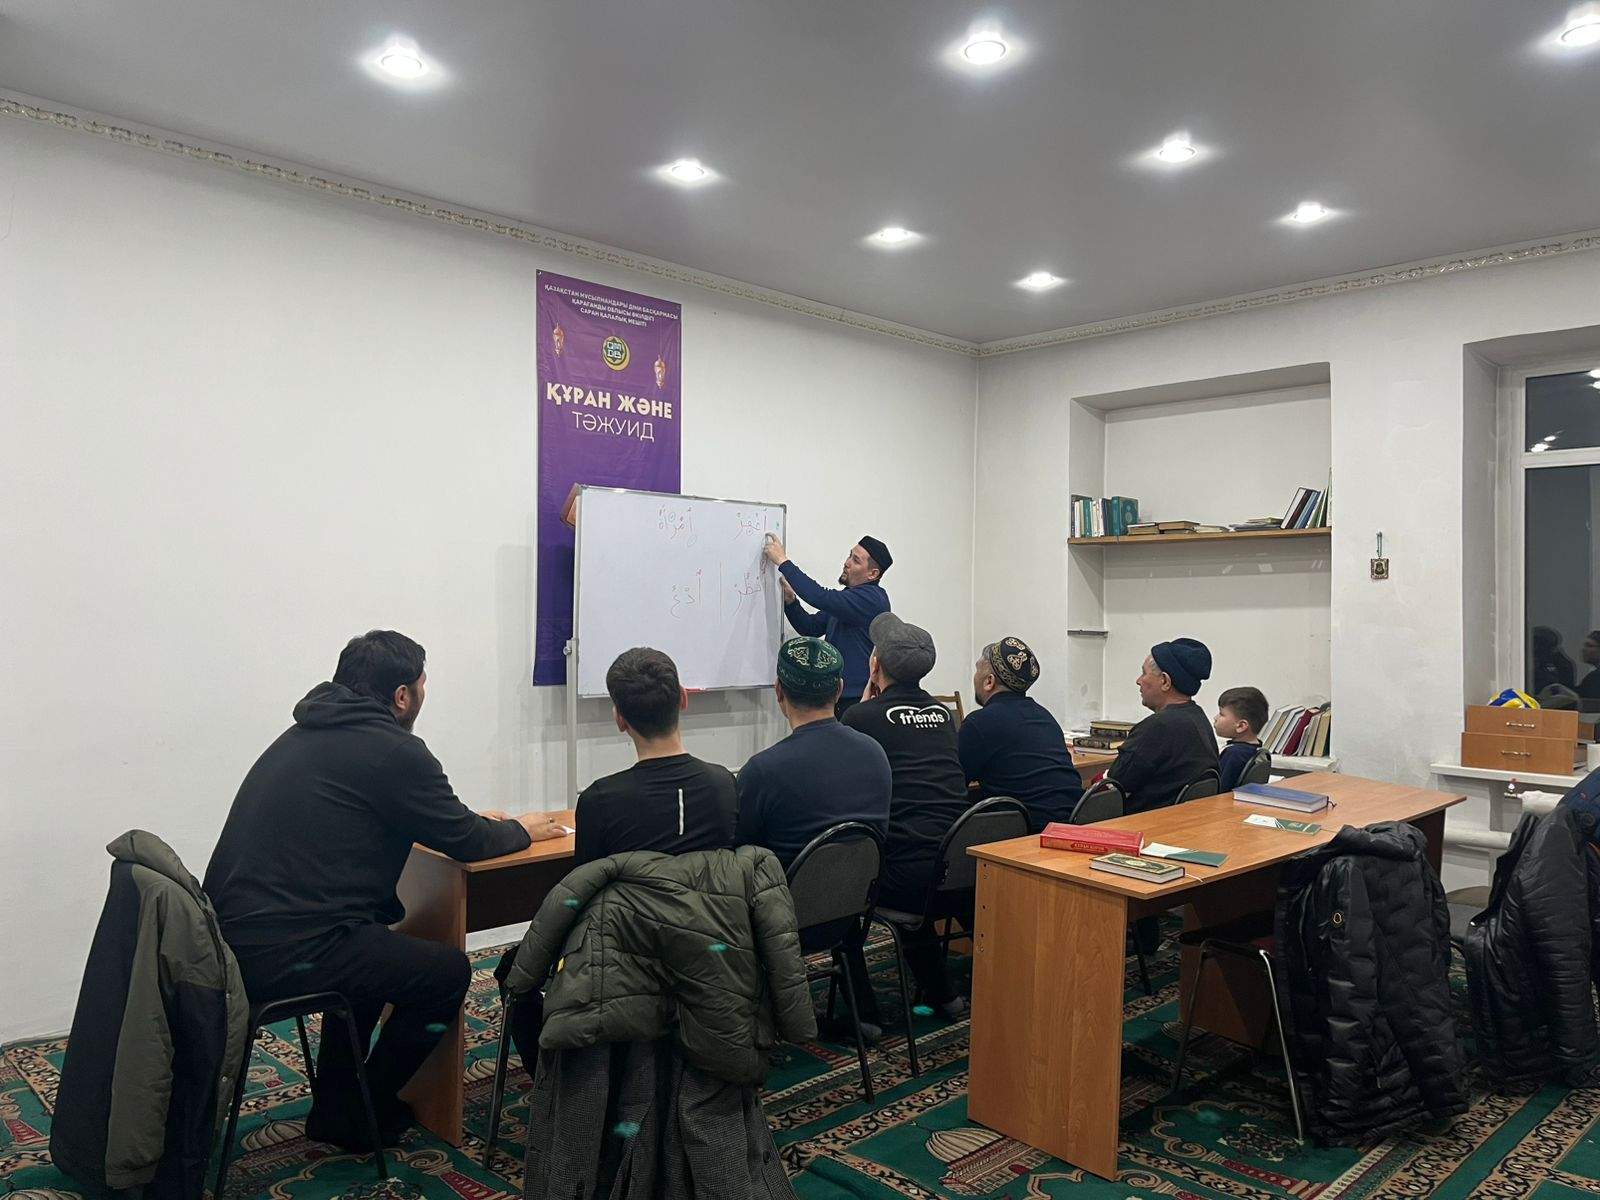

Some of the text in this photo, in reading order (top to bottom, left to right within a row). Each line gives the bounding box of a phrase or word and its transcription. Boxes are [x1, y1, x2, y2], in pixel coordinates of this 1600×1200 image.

[544, 284, 580, 297] ҚАЗАҚСТАН
[546, 382, 673, 420] ҚҰРАН ЖӘНЕ
[571, 410, 655, 443] ТӘЖУИД
[899, 709, 945, 725] friends
